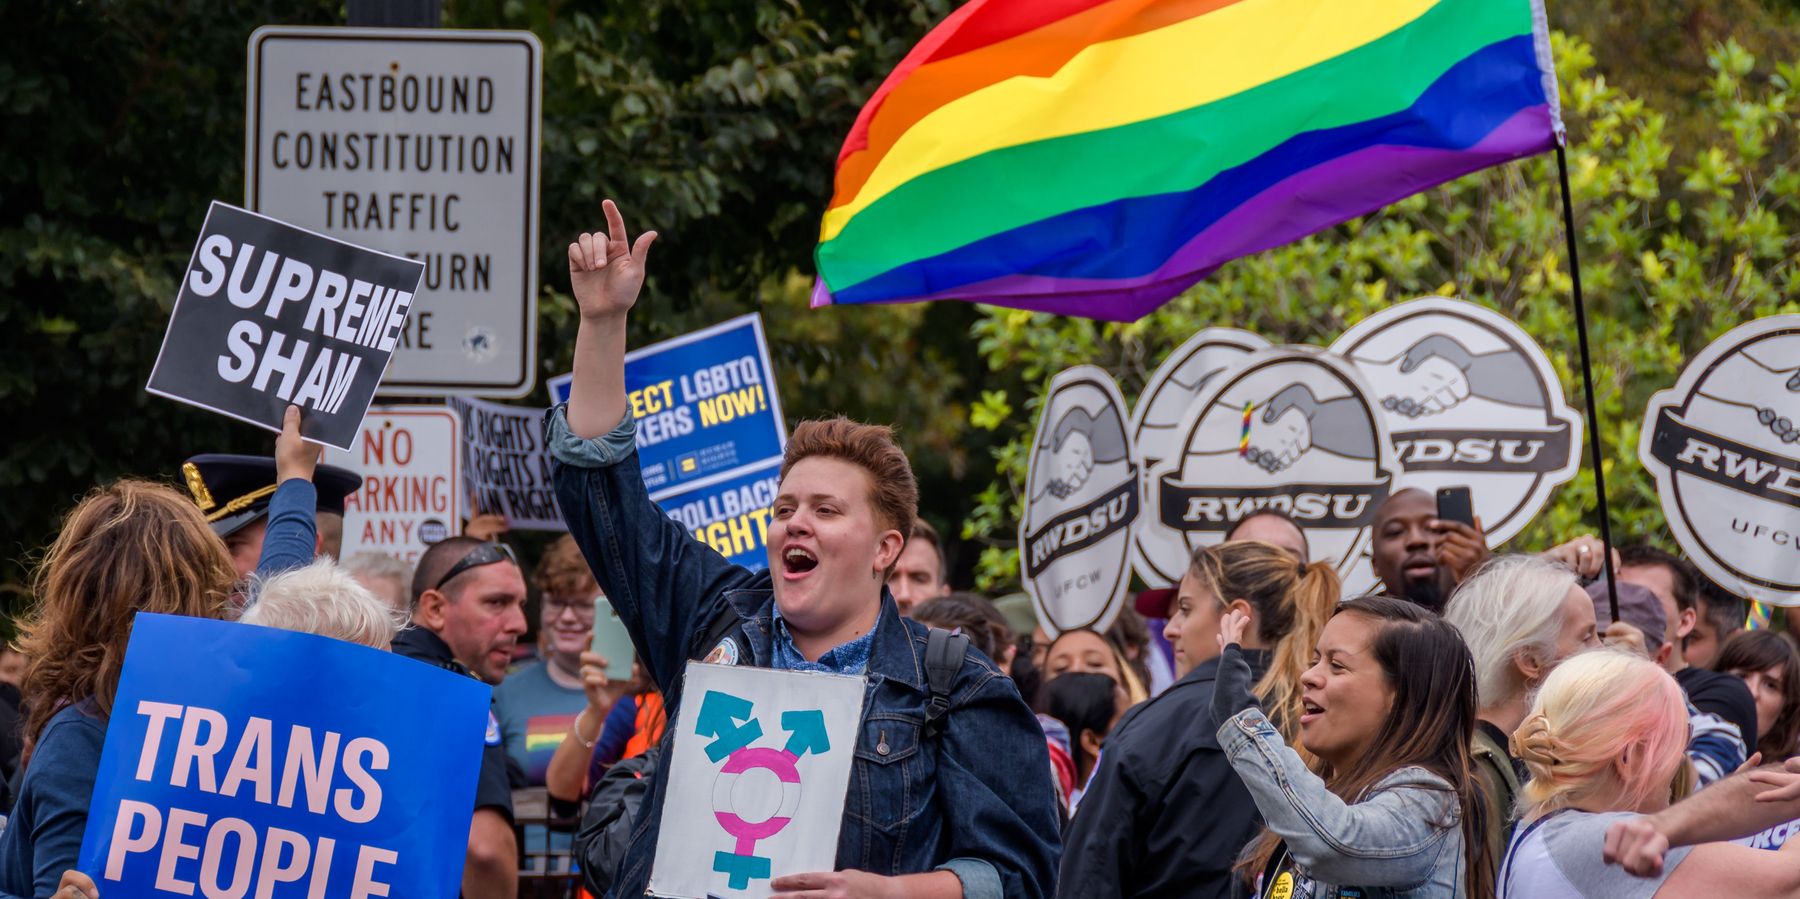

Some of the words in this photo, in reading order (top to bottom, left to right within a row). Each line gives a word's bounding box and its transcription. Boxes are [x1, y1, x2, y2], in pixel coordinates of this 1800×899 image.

[296, 73, 494, 114] EASTBOUND
[272, 131, 514, 174] CONSTITUTION
[323, 192, 460, 231] TRAFFIC
[405, 252, 490, 291] URN
[190, 234, 413, 352] SUPREME
[217, 320, 362, 414] SHAM
[680, 355, 761, 403] LGBTQ
[698, 384, 767, 428] NOW!
[363, 428, 412, 466] NO
[477, 408, 535, 451] RIGHTS
[473, 446, 535, 486] RIGHTS
[344, 476, 447, 513] ARKING
[1183, 493, 1371, 522] RWDSU
[361, 520, 414, 544] ANY
[1031, 491, 1130, 568] RWDSU
[1054, 567, 1102, 599] UFCW
[135, 700, 390, 824] TRANS
[104, 799, 399, 899] PEOPLE
